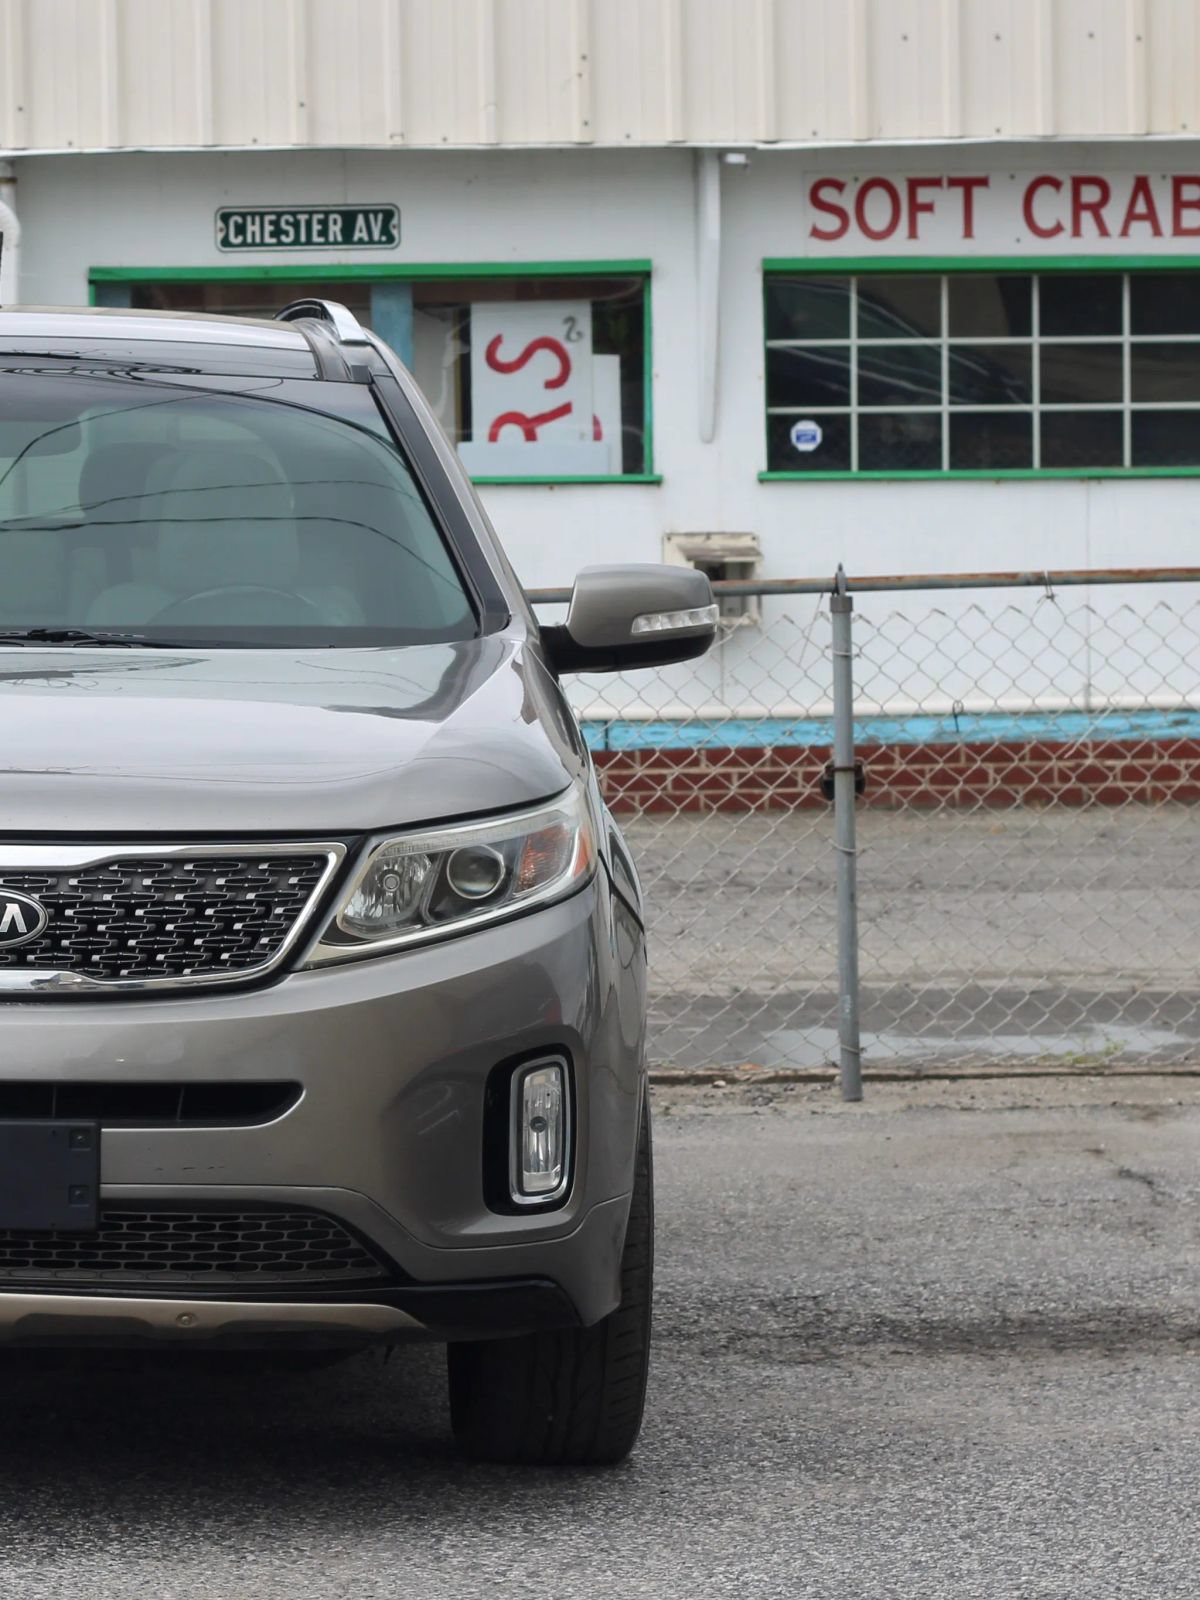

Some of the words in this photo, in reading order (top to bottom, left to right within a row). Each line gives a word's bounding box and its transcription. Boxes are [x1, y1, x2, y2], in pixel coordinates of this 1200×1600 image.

[227, 212, 343, 245] CHESTER
[352, 211, 388, 243] AV.
[808, 174, 990, 241] SOFT
